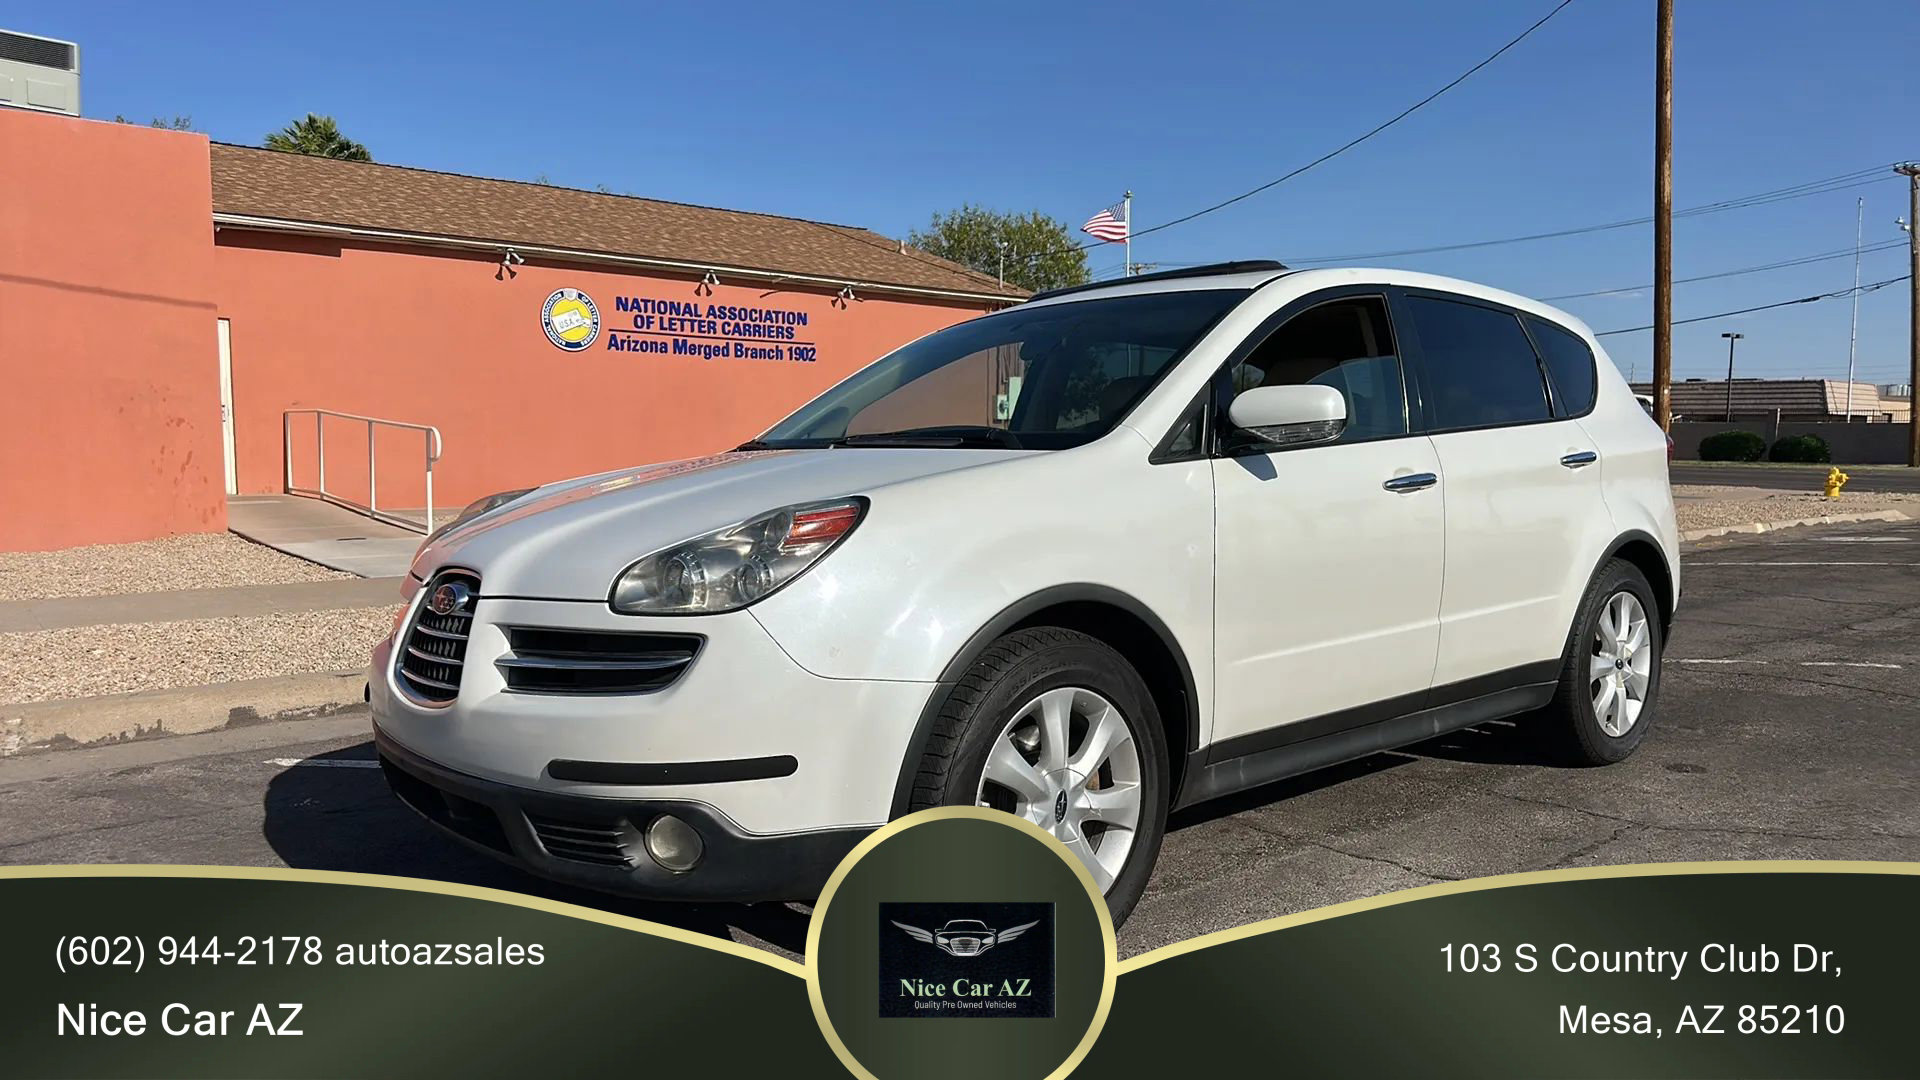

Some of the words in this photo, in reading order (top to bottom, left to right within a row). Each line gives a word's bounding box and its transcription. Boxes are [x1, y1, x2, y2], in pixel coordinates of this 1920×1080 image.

[615, 296, 702, 318] NATIONAL
[706, 304, 808, 326] ASSOCIATION
[633, 314, 655, 330] OF
[659, 316, 717, 335] LETTER
[721, 321, 795, 340] CARRIERS
[607, 333, 668, 354] Arizona
[672, 338, 730, 360] Merged
[734, 342, 784, 361] Branch
[787, 346, 817, 362] 1902
